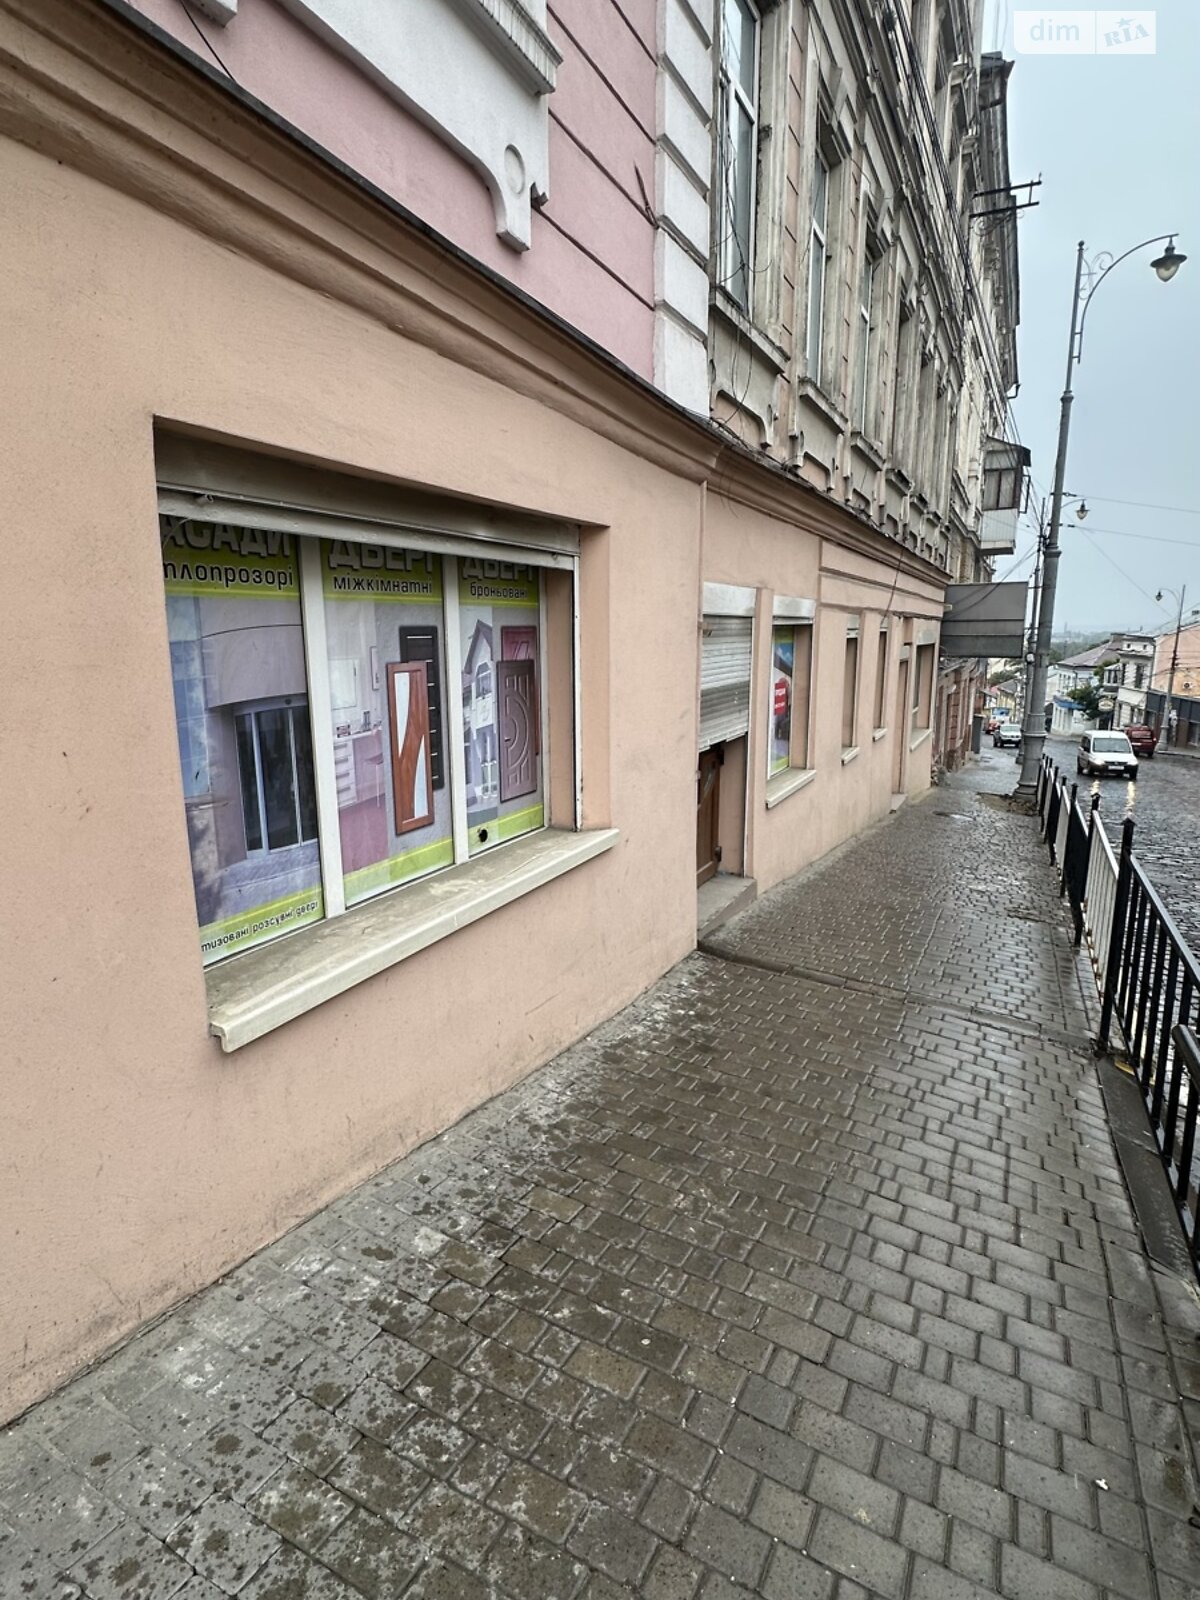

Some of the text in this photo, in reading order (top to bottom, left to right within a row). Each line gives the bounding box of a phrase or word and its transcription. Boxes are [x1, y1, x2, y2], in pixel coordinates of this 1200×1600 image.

[333, 573, 433, 594] міжкімнатні
[252, 910, 293, 934] розсувні
[295, 901, 319, 917] двері
